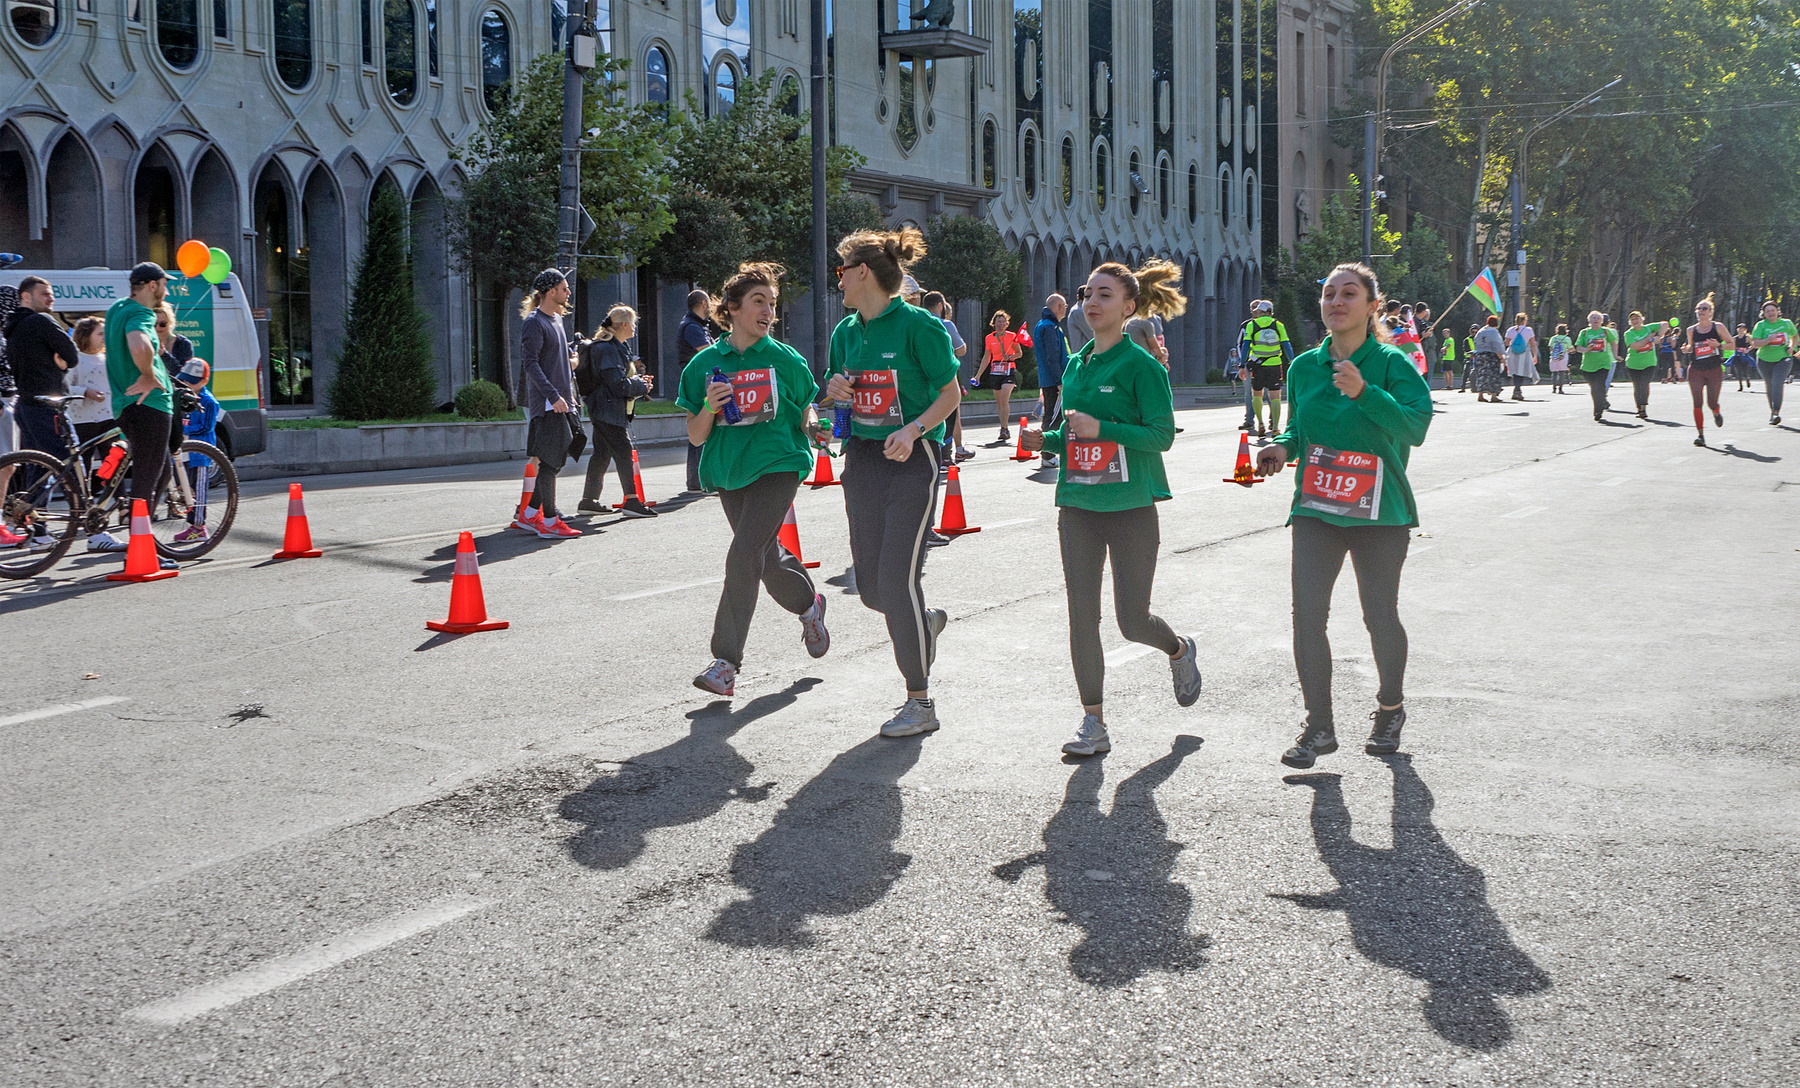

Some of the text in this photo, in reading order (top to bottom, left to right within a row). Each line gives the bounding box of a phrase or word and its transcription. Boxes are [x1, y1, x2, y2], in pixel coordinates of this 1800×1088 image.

[53, 285, 116, 299] BULANCE
[170, 285, 190, 297] 112
[745, 372, 756, 381] 10
[869, 373, 878, 382] 10
[738, 390, 757, 405] 10
[1348, 455, 1362, 465] 10
[1313, 470, 1357, 492] 3119
